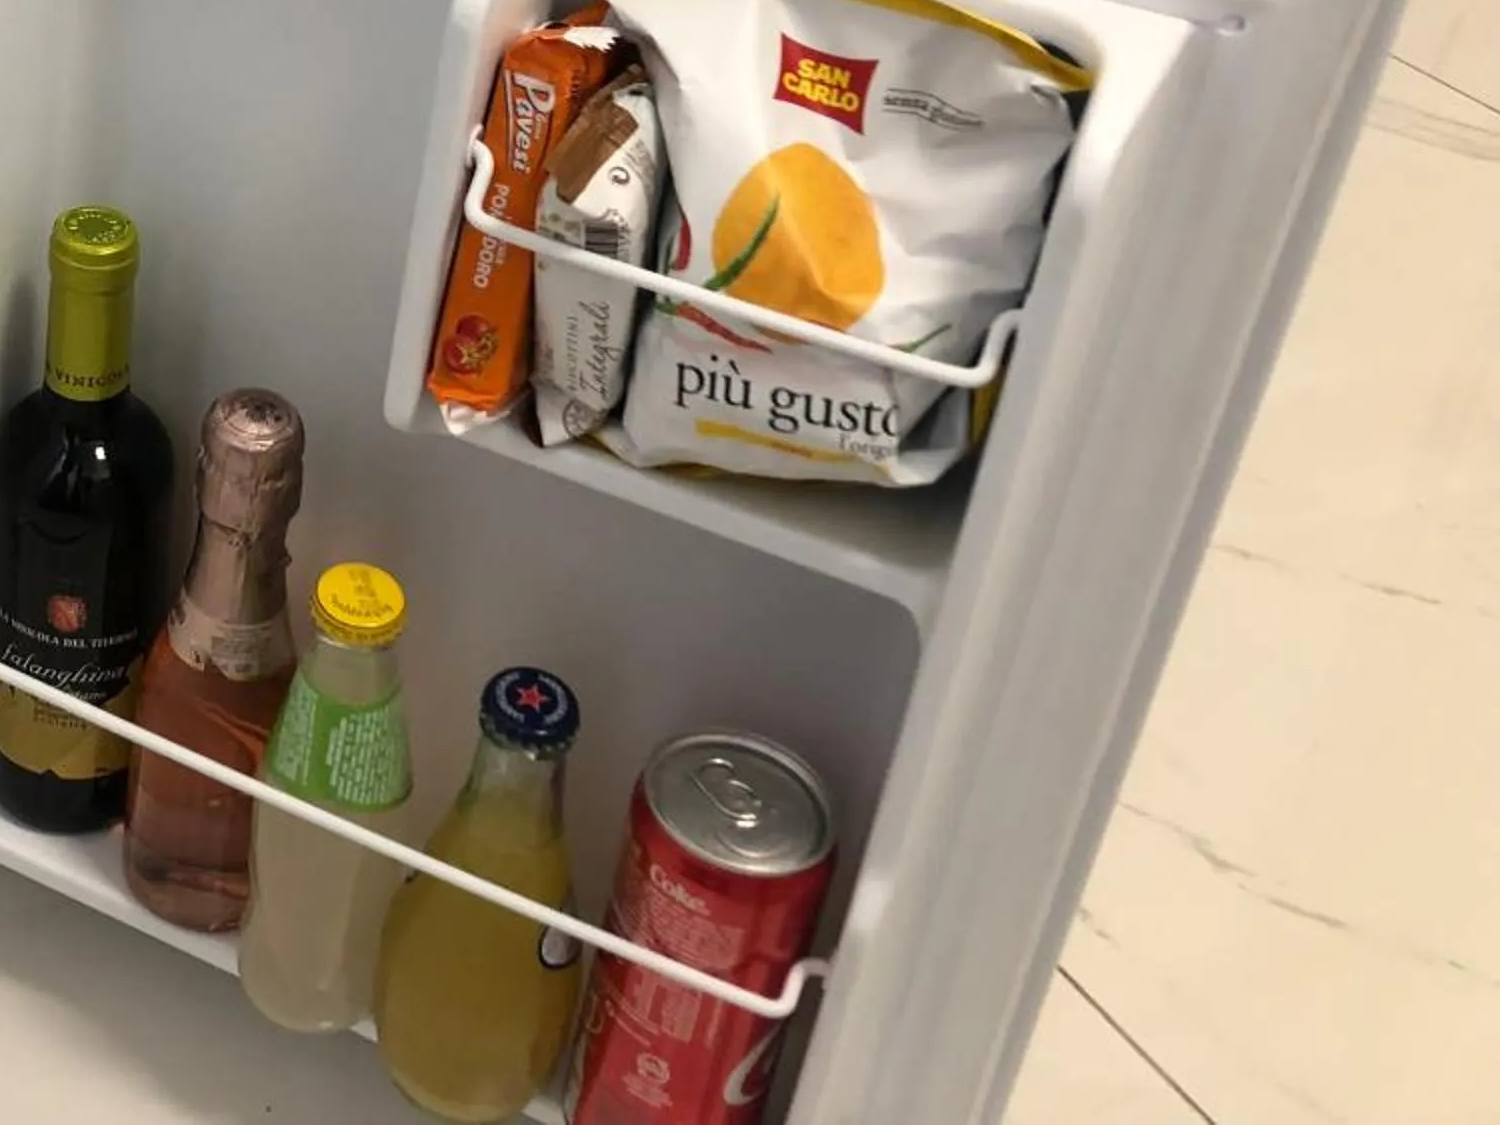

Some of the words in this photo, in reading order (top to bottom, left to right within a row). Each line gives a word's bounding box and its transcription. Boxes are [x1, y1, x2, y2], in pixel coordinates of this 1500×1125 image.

[782, 72, 860, 112] CARLO
[798, 58, 850, 88] SAN
[512, 71, 556, 174] Pavesi
[674, 354, 753, 410] più
